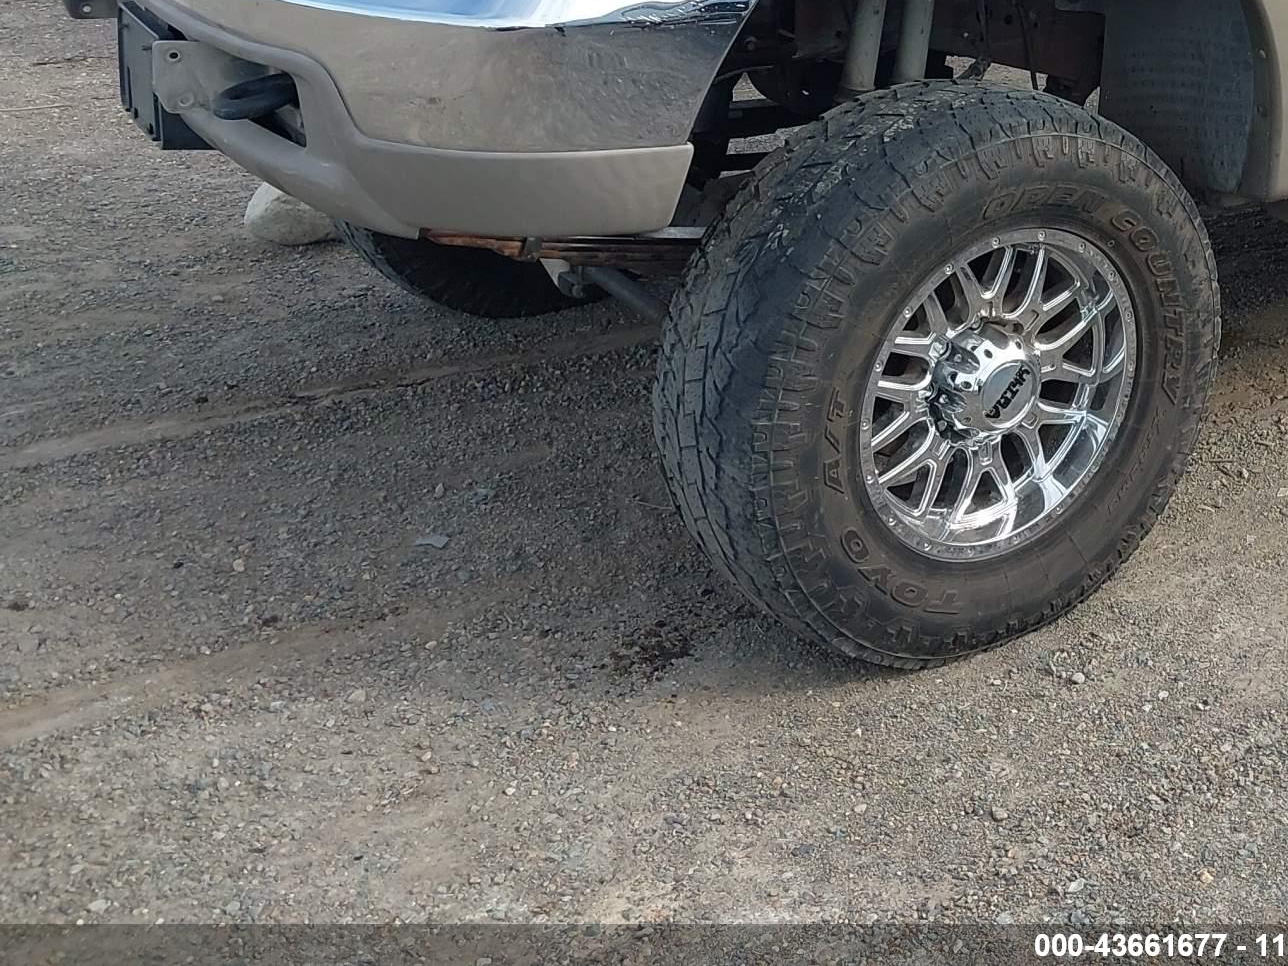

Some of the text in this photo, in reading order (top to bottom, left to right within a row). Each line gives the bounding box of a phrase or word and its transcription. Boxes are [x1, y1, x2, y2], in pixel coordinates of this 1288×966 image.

[982, 184, 1187, 407] OPEN COUNTRY
[823, 386, 851, 495] A/T
[840, 527, 962, 615] TOYO
